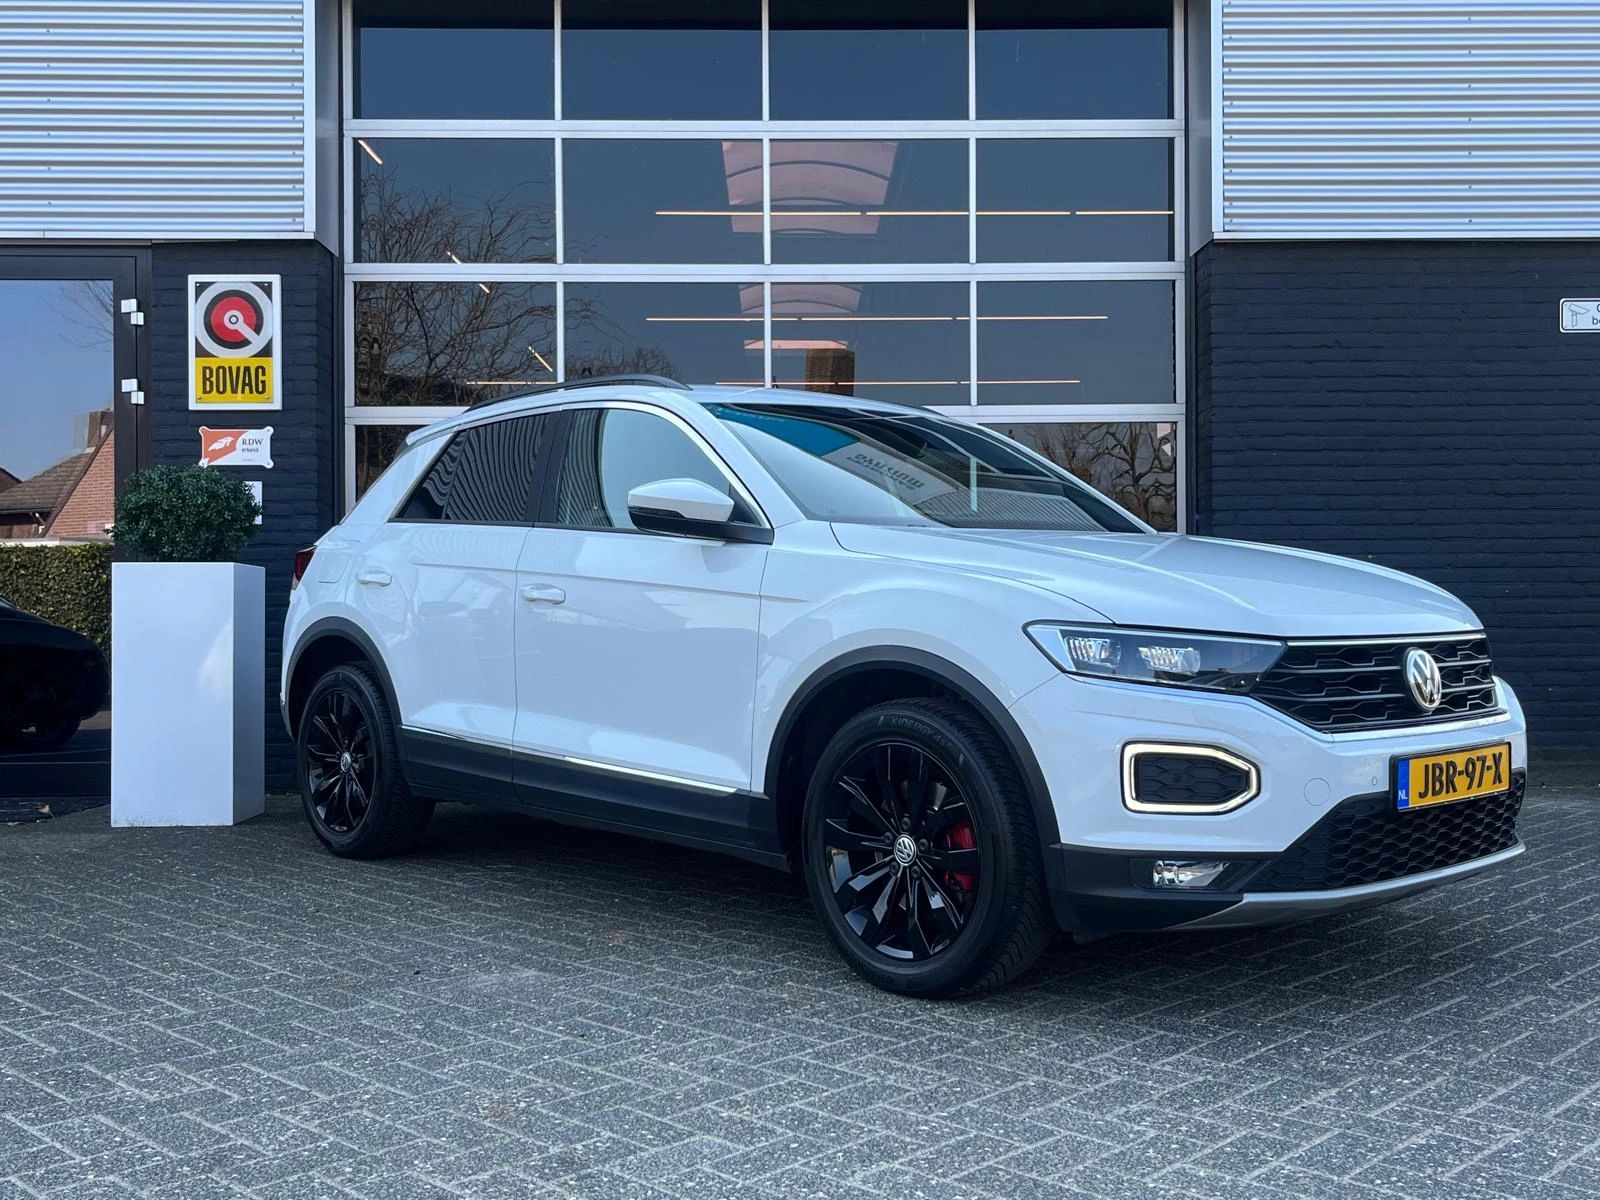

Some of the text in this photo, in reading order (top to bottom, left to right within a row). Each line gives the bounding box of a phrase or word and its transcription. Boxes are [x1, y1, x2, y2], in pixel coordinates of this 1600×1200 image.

[202, 366, 266, 394] BOVAG
[1418, 752, 1503, 799] JBR-97-X
[1398, 790, 1408, 800] NL
